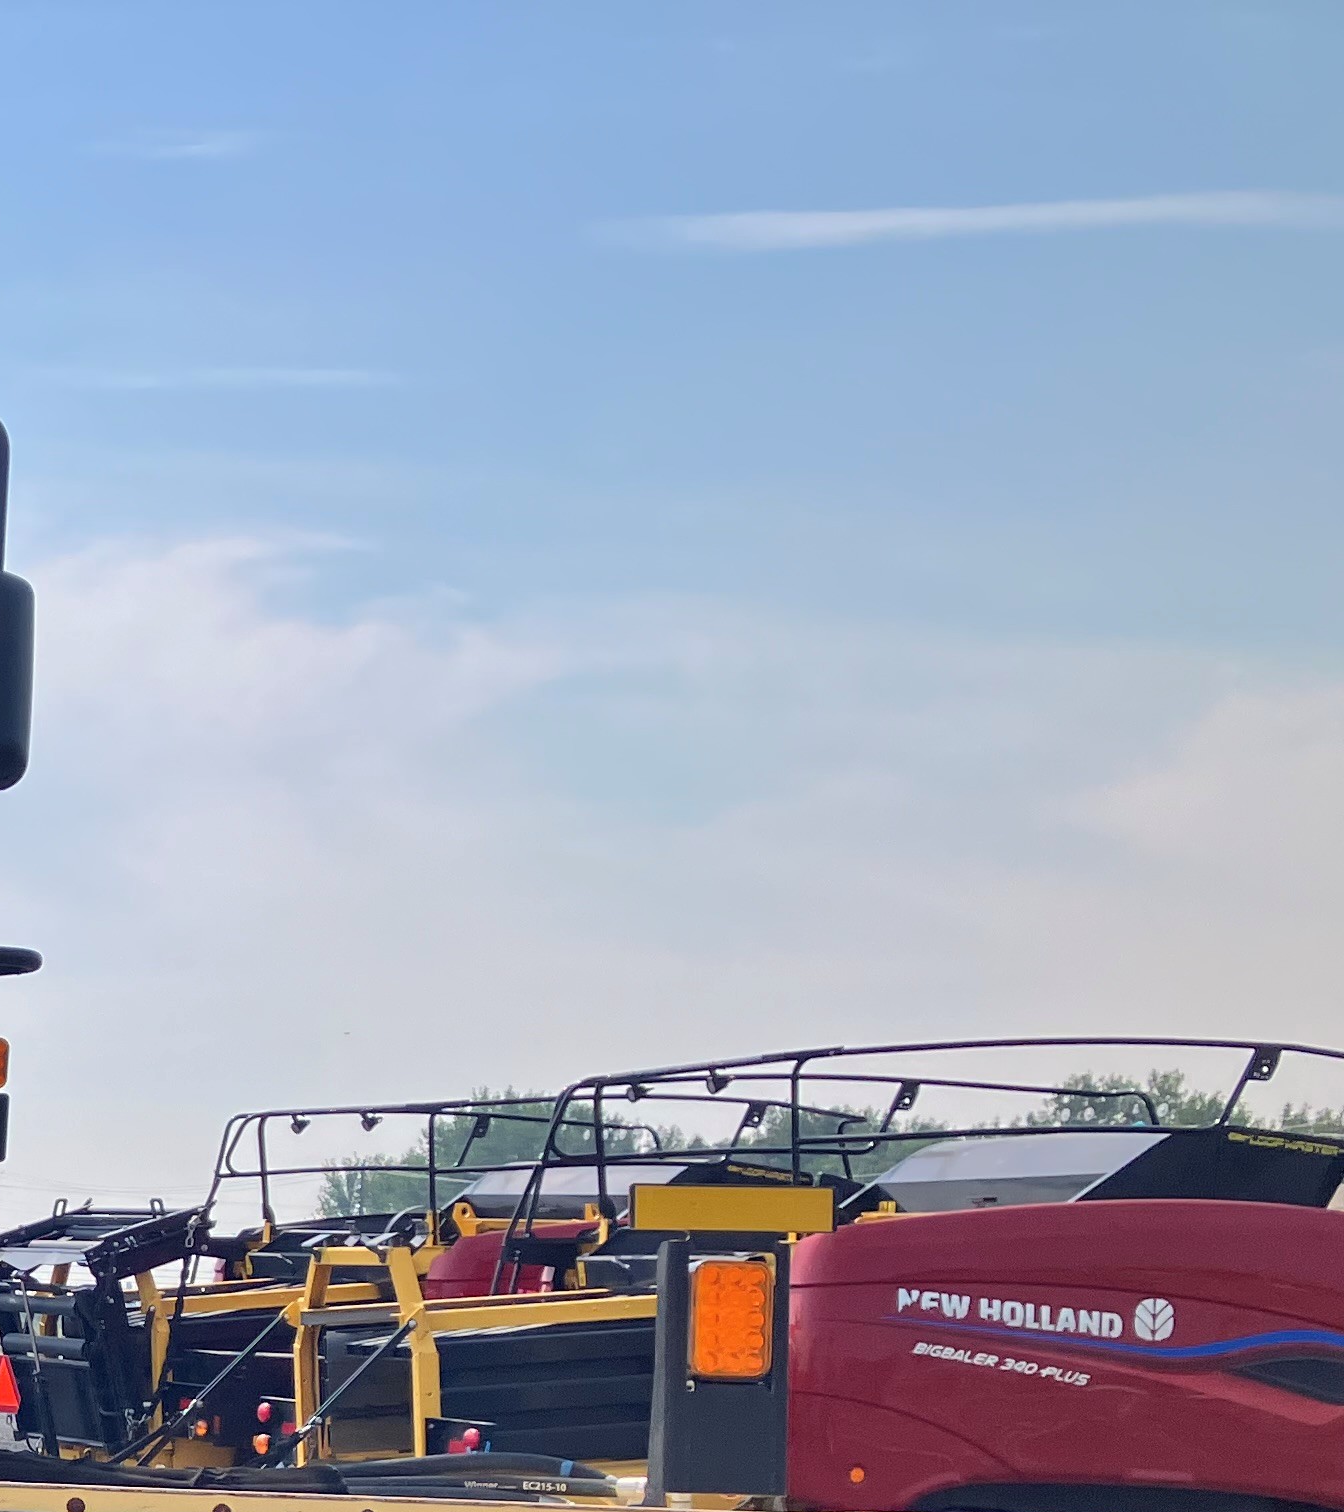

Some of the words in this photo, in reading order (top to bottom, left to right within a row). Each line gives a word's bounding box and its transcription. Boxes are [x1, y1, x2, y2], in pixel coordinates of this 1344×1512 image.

[897, 1287, 971, 1320] NEW
[979, 1297, 1123, 1338] HOLLAND
[912, 1342, 999, 1367] BIGBALER
[1040, 1366, 1091, 1386] PLUS
[522, 1481, 567, 1492] EC215-10
